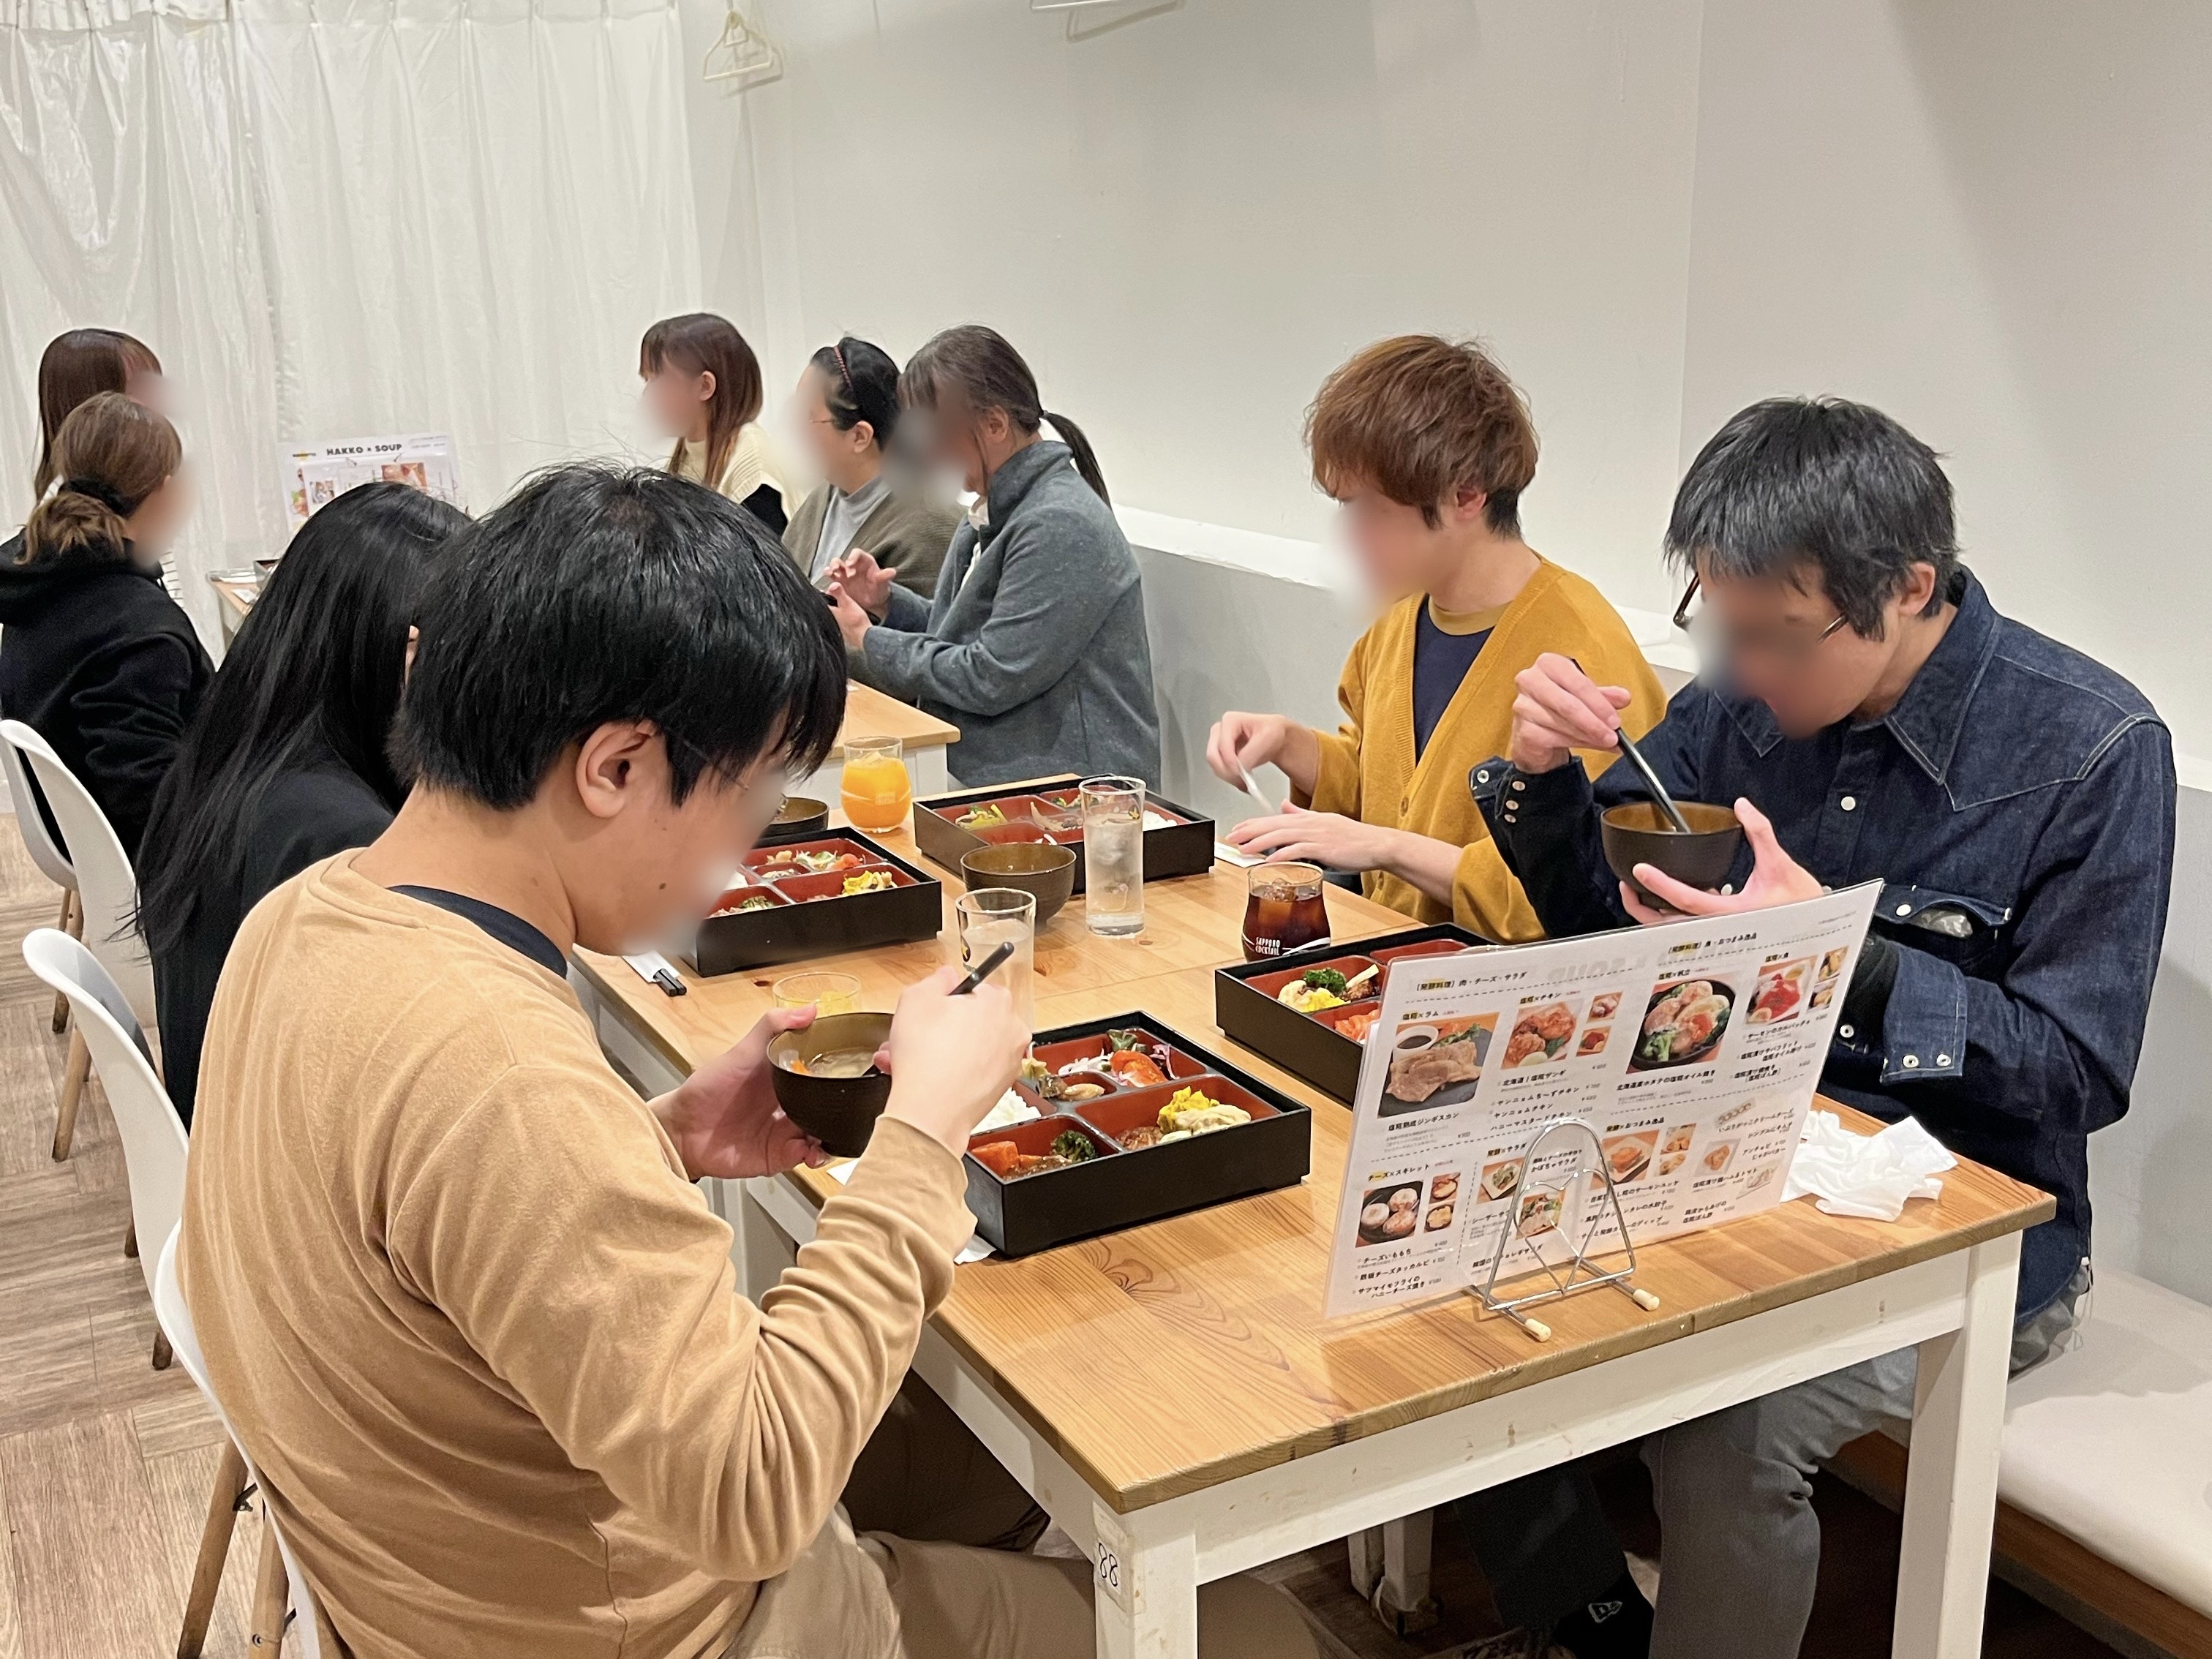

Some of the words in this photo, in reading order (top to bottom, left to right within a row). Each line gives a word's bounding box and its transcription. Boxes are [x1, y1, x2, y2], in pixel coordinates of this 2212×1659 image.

[327, 447, 363, 455] HAKKO
[375, 444, 402, 452] SOUP
[1256, 937, 1280, 948] SAPPORO
[1255, 945, 1279, 955] COCKTAIL
